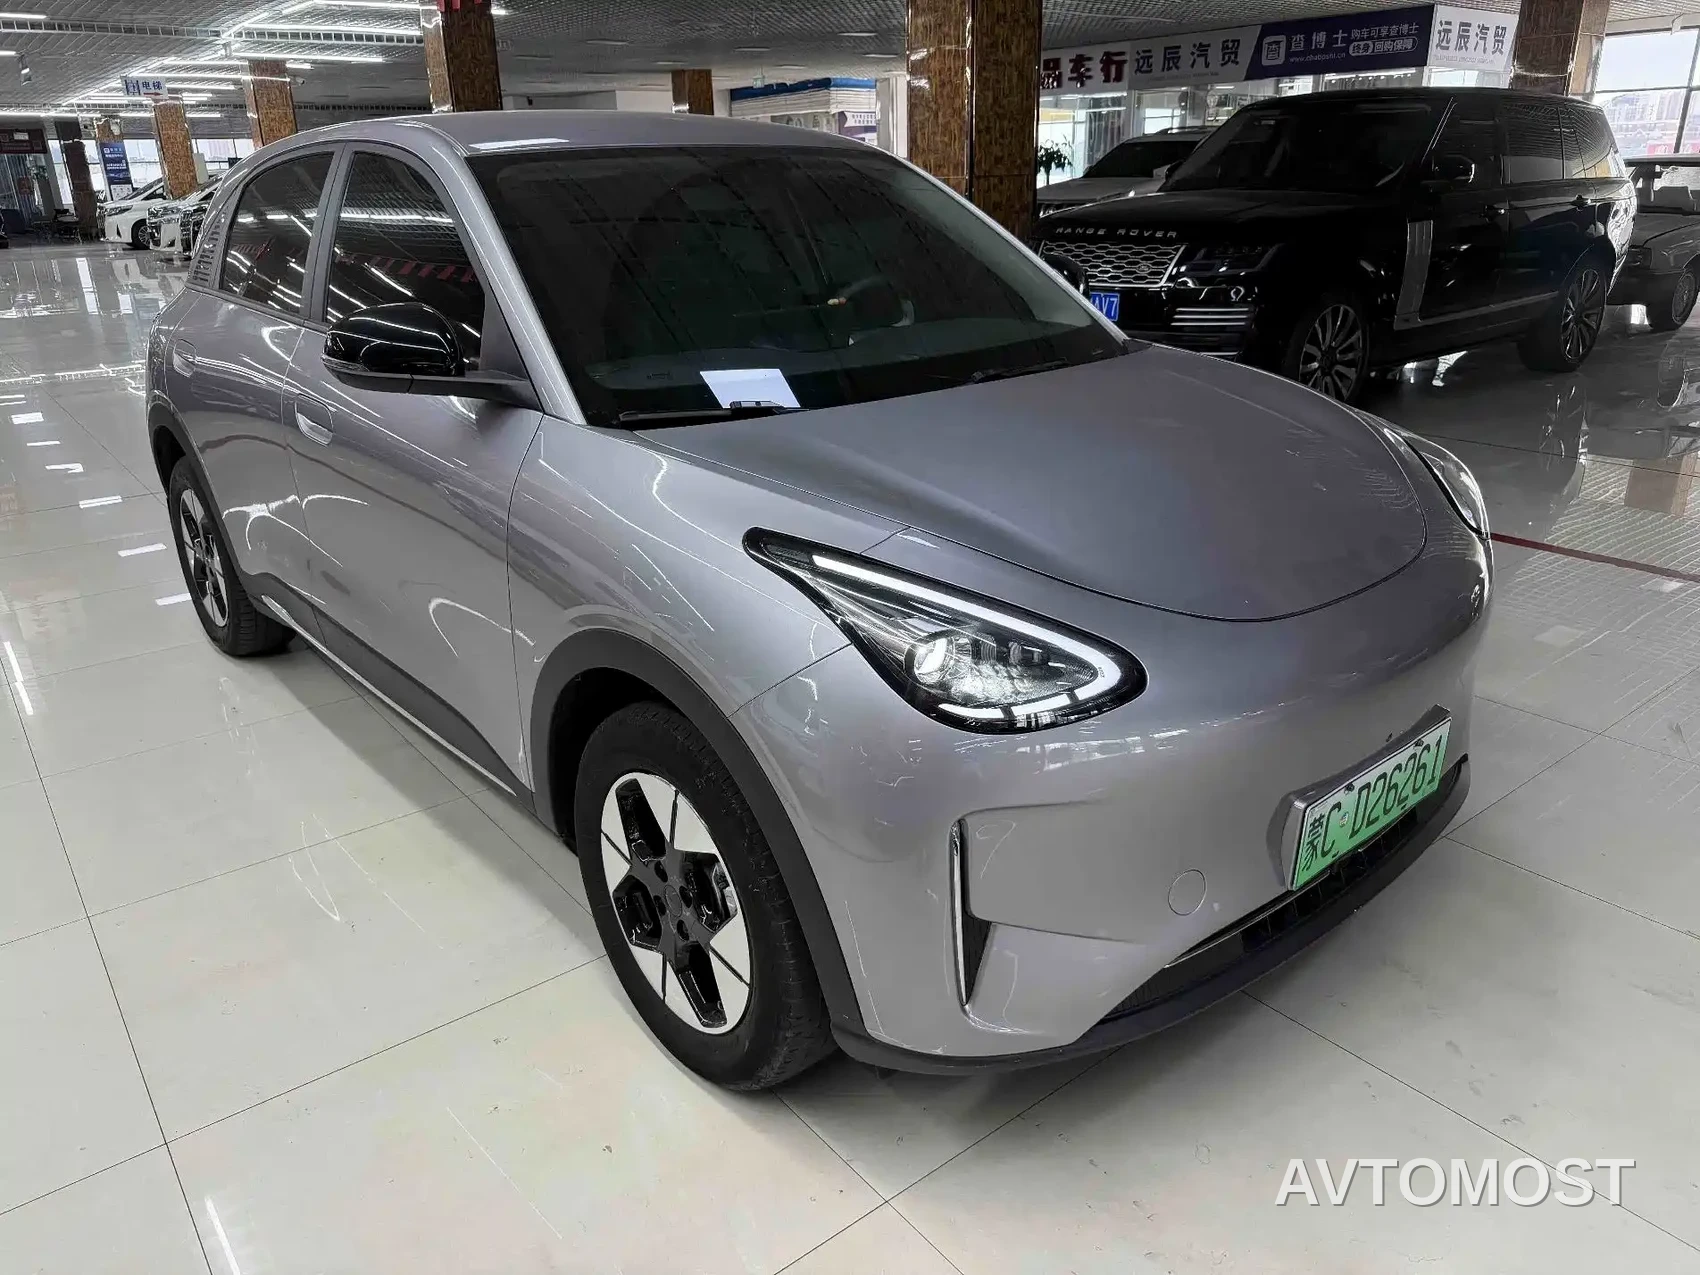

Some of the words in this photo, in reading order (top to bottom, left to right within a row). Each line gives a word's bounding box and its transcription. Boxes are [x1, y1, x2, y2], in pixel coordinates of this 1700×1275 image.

[1290, 30, 1348, 51] 查博士
[1436, 20, 1507, 55] 远辰汽贸
[1135, 39, 1241, 75] 远辰汽贸
[141, 81, 162, 90] 电梯
[1056, 227, 1106, 235] RANGE
[1117, 228, 1177, 238] ROVER
